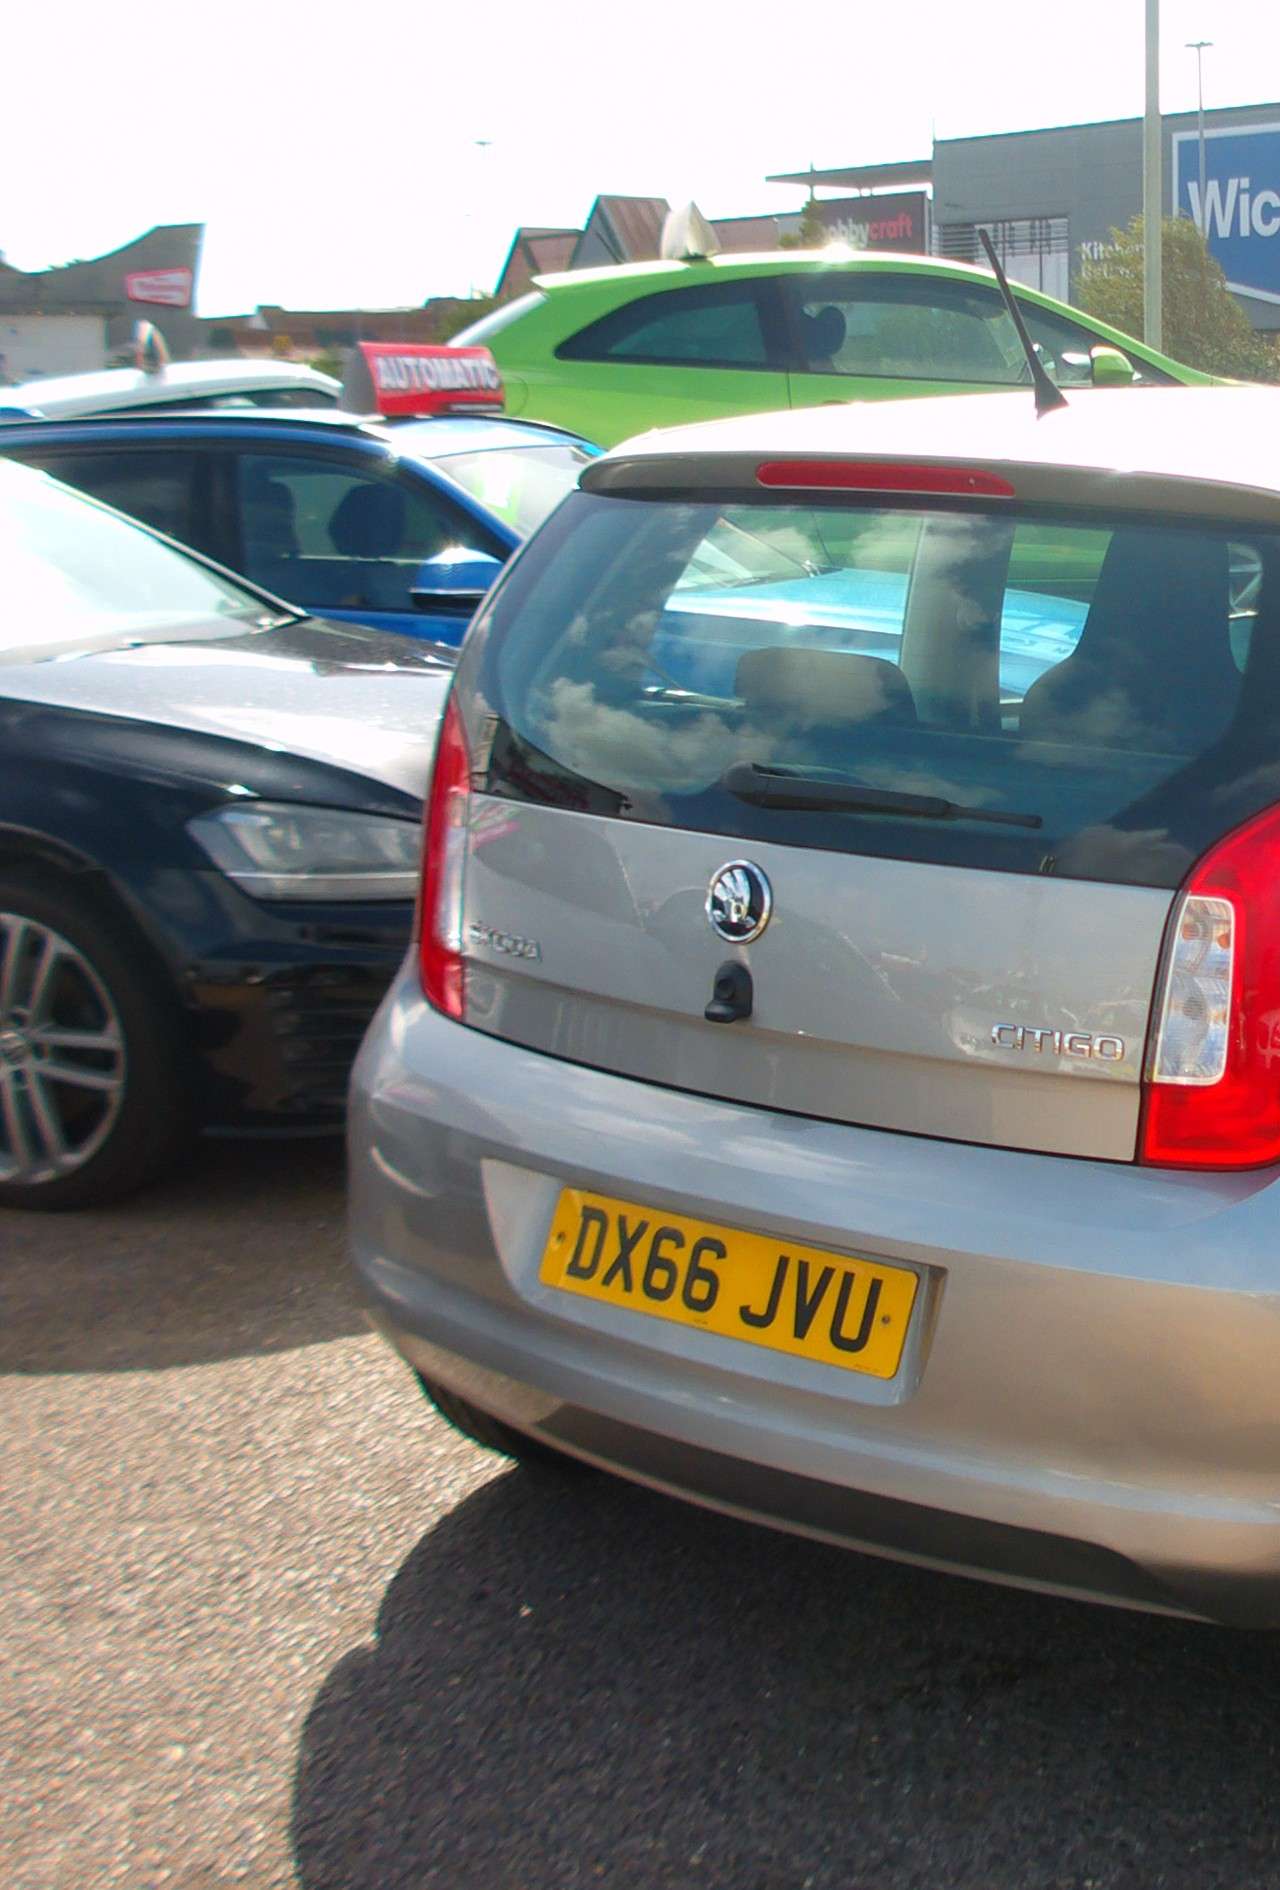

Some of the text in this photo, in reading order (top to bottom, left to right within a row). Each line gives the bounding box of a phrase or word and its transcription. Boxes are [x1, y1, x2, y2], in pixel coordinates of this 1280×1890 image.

[376, 356, 502, 390] AUTOMATIC
[991, 1022, 1126, 1063] CITIGO
[566, 1204, 884, 1353] DX66 JVU
